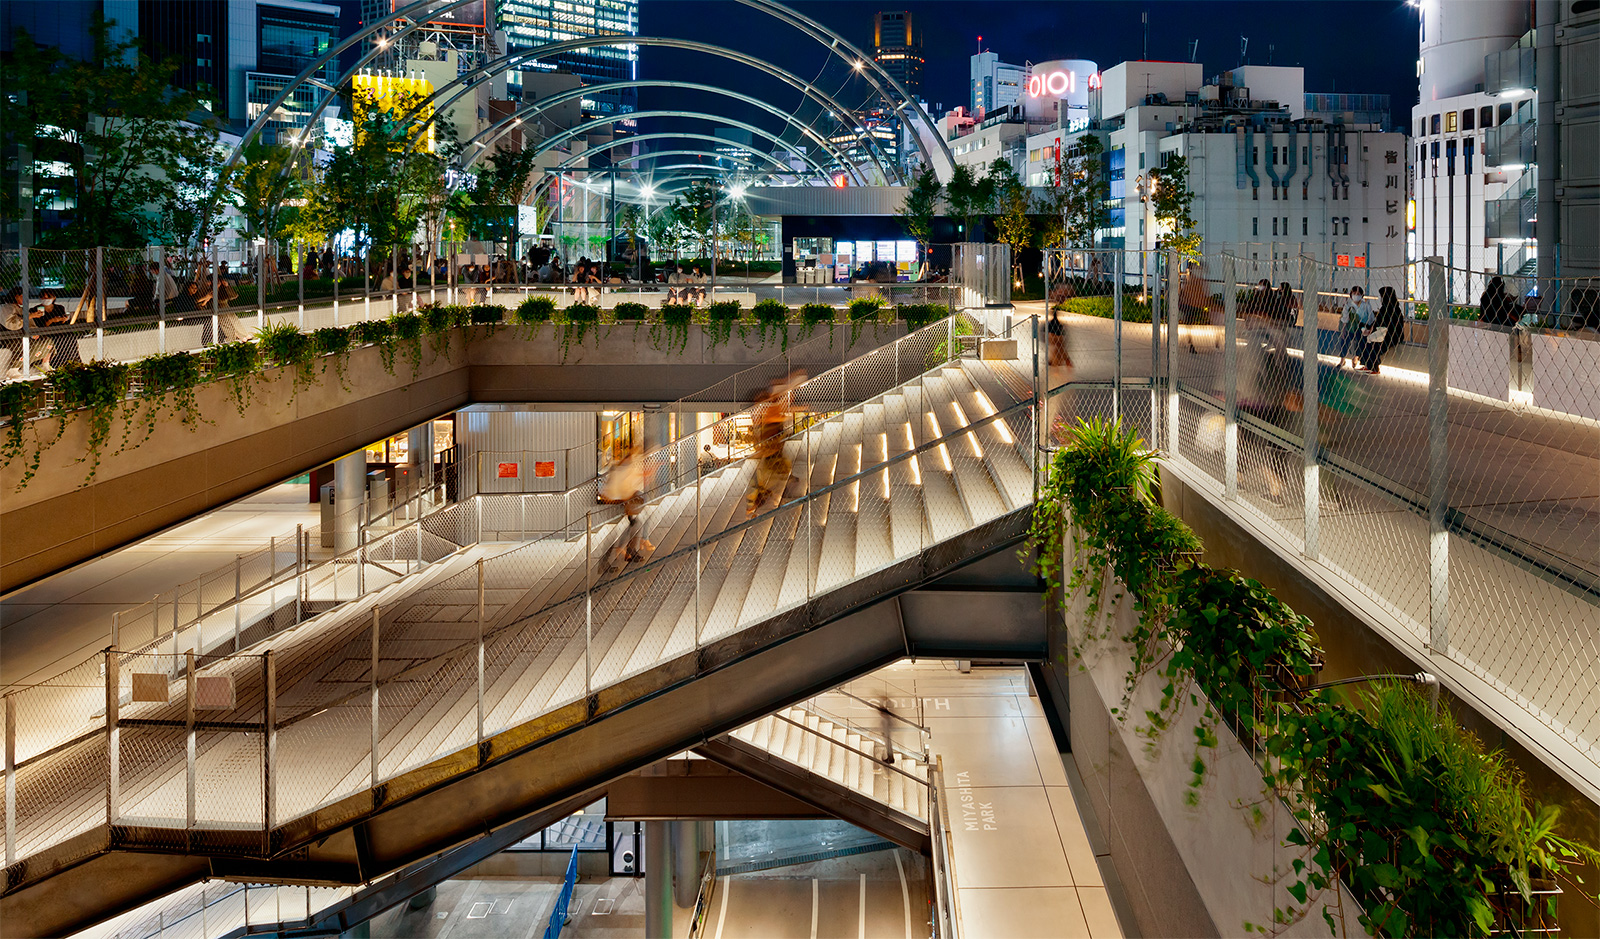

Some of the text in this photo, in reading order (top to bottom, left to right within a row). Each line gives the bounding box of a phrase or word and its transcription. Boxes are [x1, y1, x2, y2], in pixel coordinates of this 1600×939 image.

[1384, 150, 1399, 239] 皆川ビル
[956, 770, 979, 831] MIYASHITA
[979, 801, 998, 831] PARK
